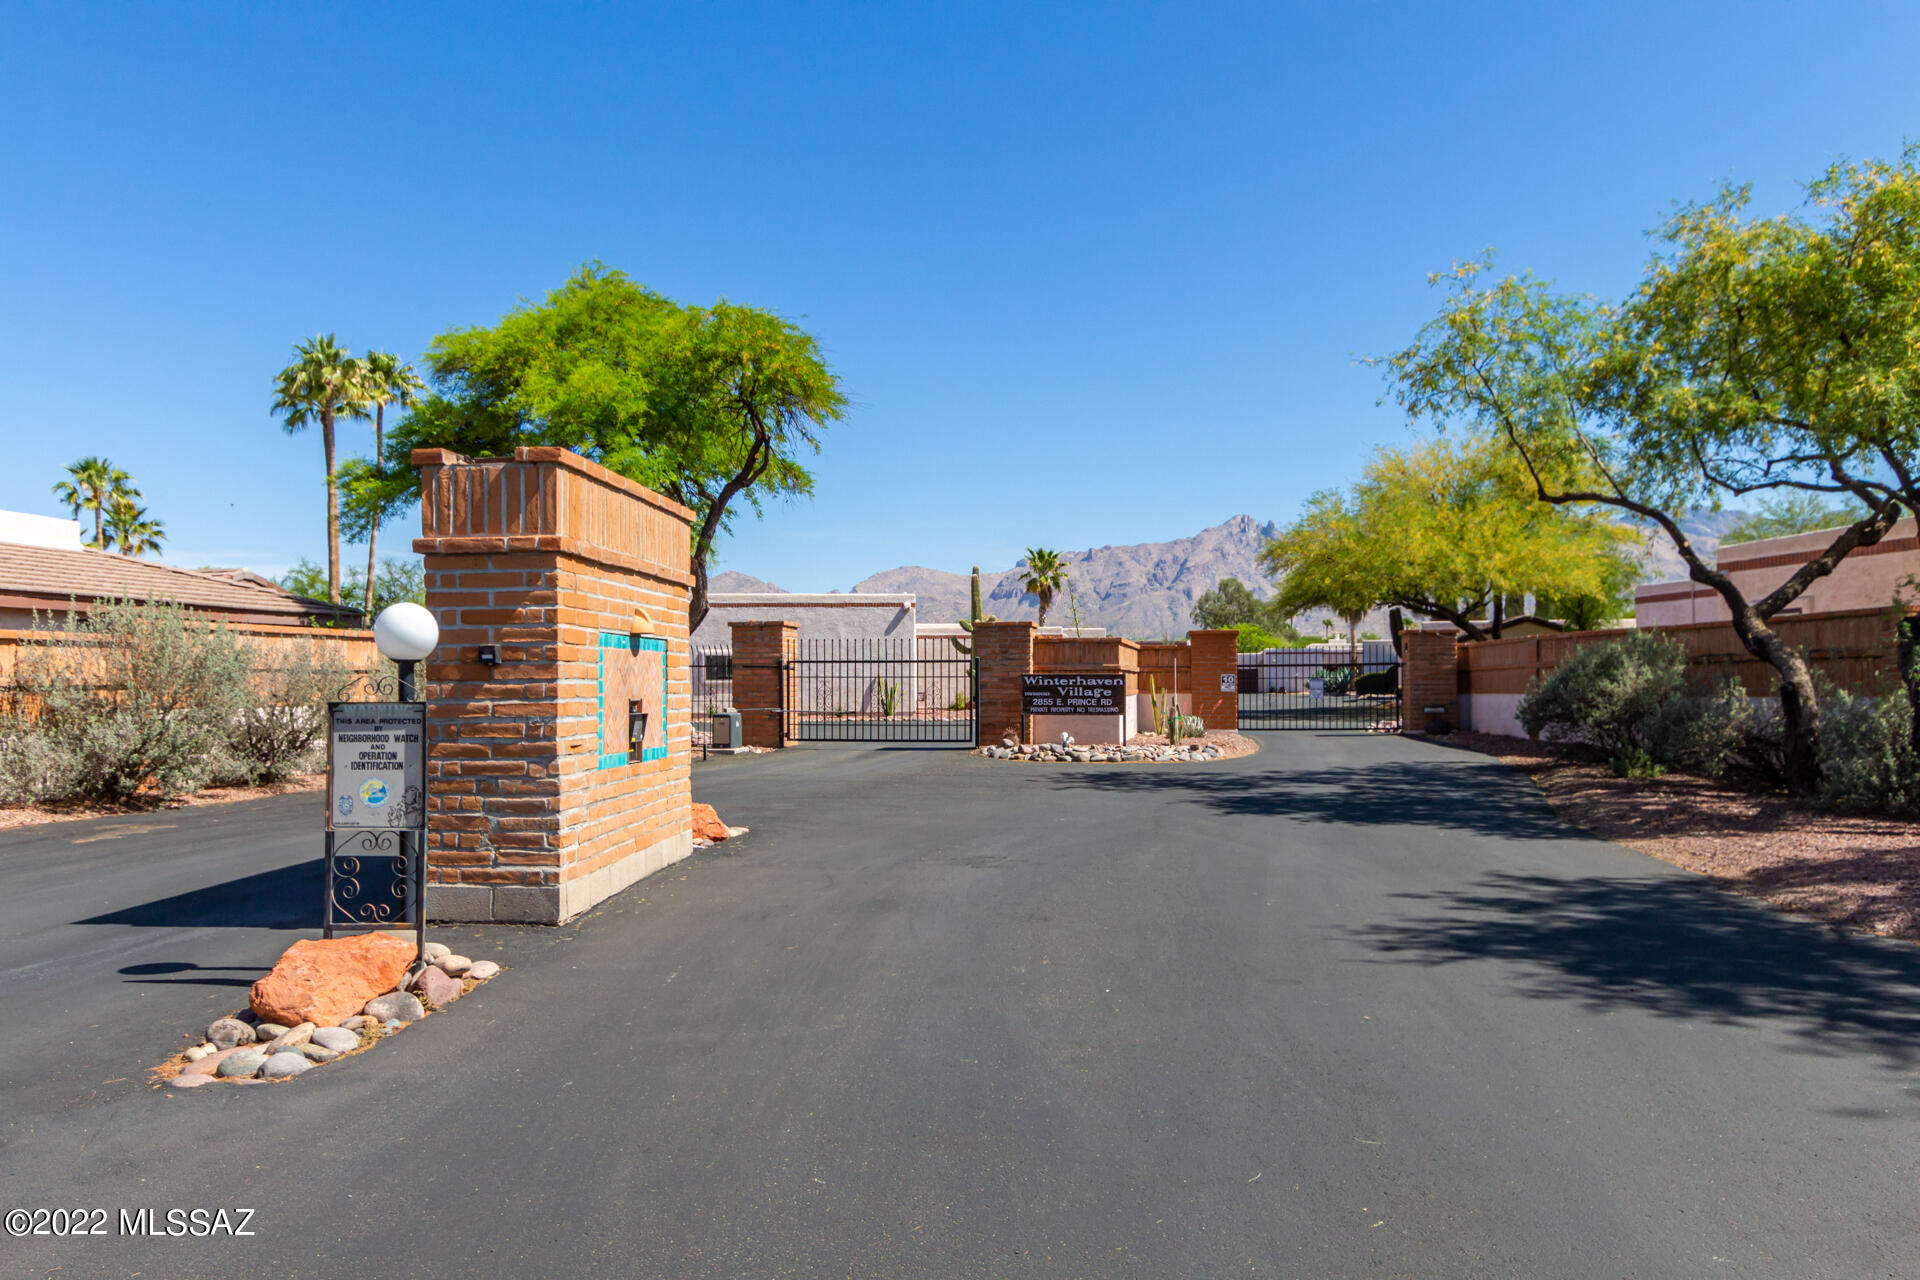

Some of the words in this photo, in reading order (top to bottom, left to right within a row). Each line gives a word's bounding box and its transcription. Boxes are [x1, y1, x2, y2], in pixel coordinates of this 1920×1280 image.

[1024, 676, 1123, 686] Winterhaven
[1057, 687, 1112, 698] Village
[338, 734, 389, 743] NEIGHBORHOOD
[393, 734, 419, 743] WATCH
[358, 751, 397, 760] OPERATION
[350, 761, 404, 770] IDENTIFICATION
